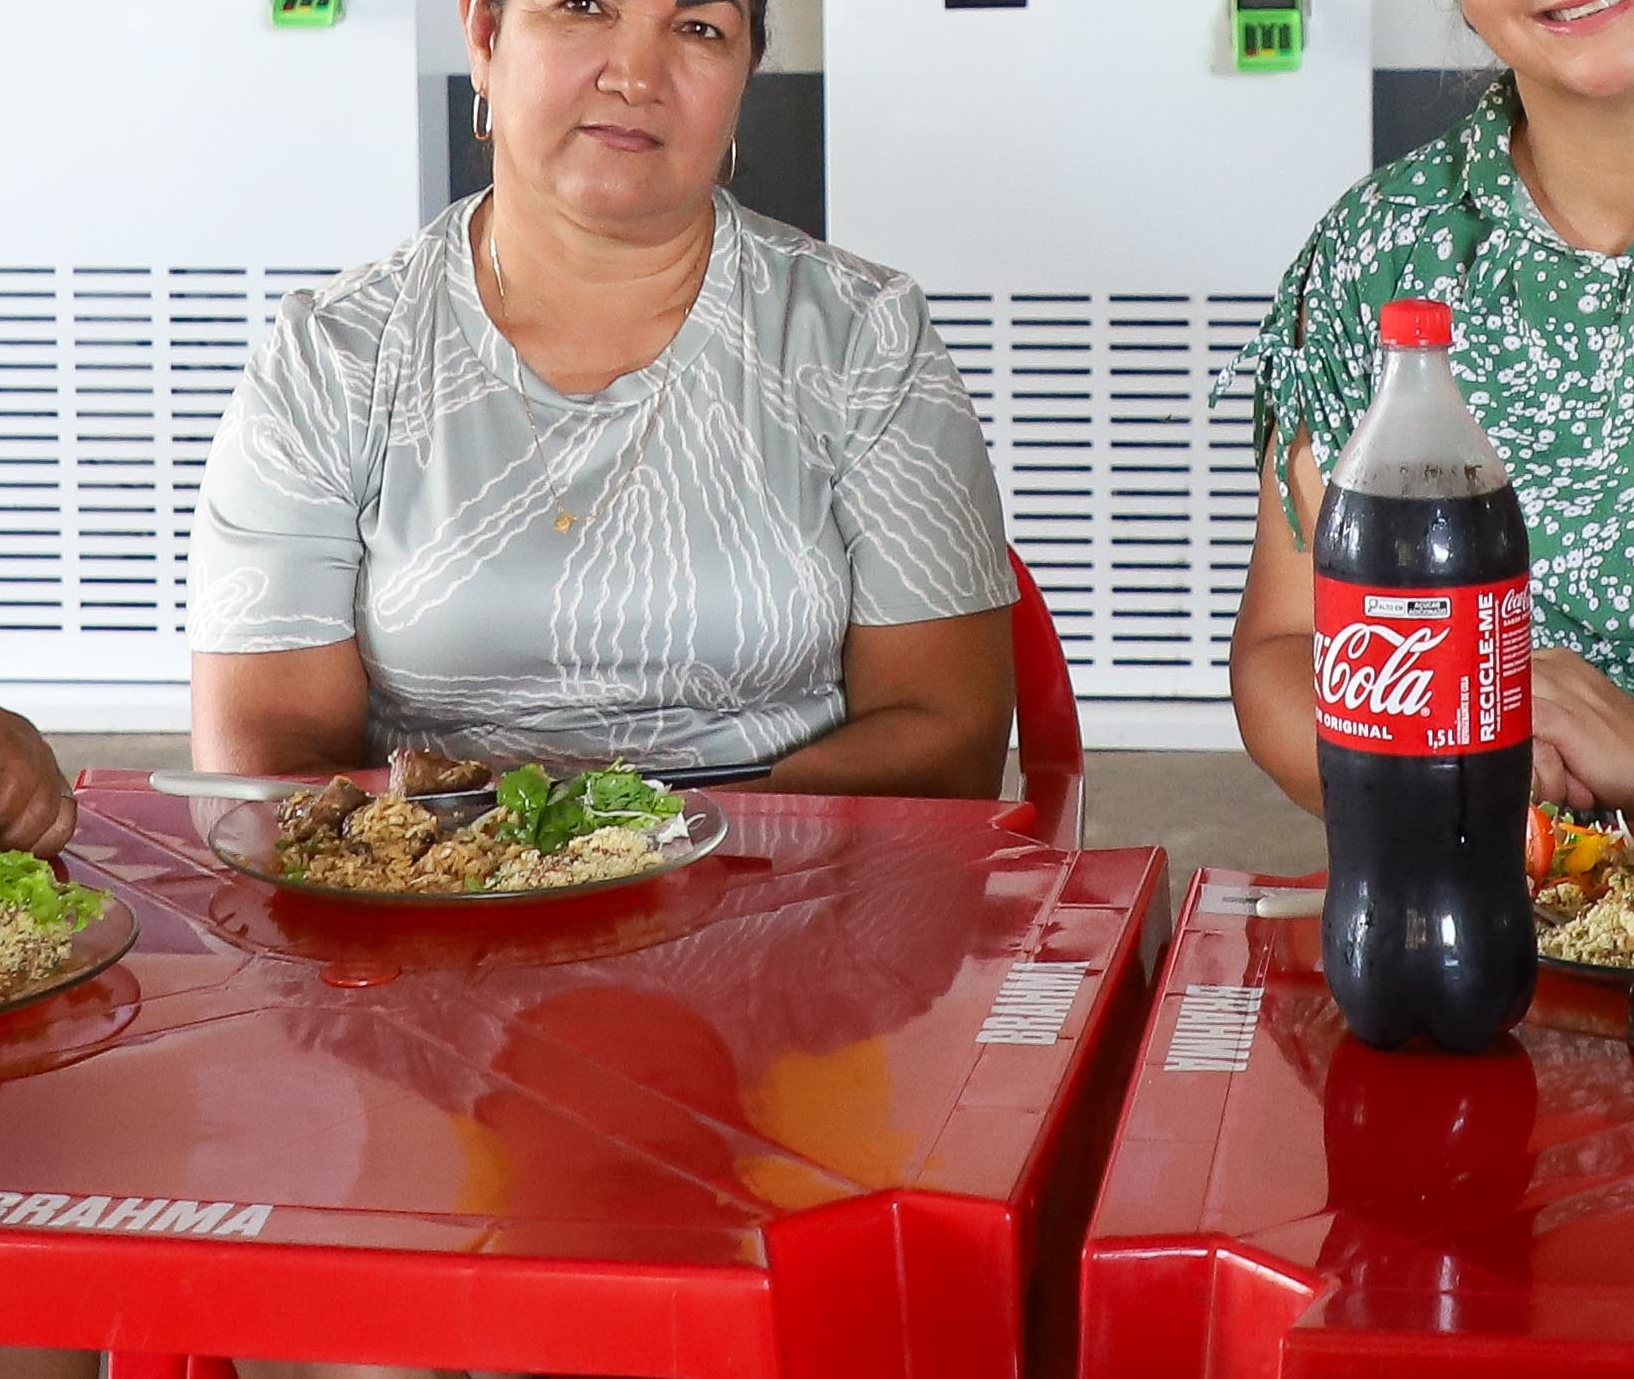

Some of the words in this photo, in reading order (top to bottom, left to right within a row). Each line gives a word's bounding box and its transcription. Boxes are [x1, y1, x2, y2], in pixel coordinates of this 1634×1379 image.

[1477, 592, 1496, 743] RECICLE-ME
[1323, 715, 1393, 741] ORIGINAL
[975, 960, 1091, 1046] BRAHMA
[1163, 983, 1265, 1072] BRAHMA
